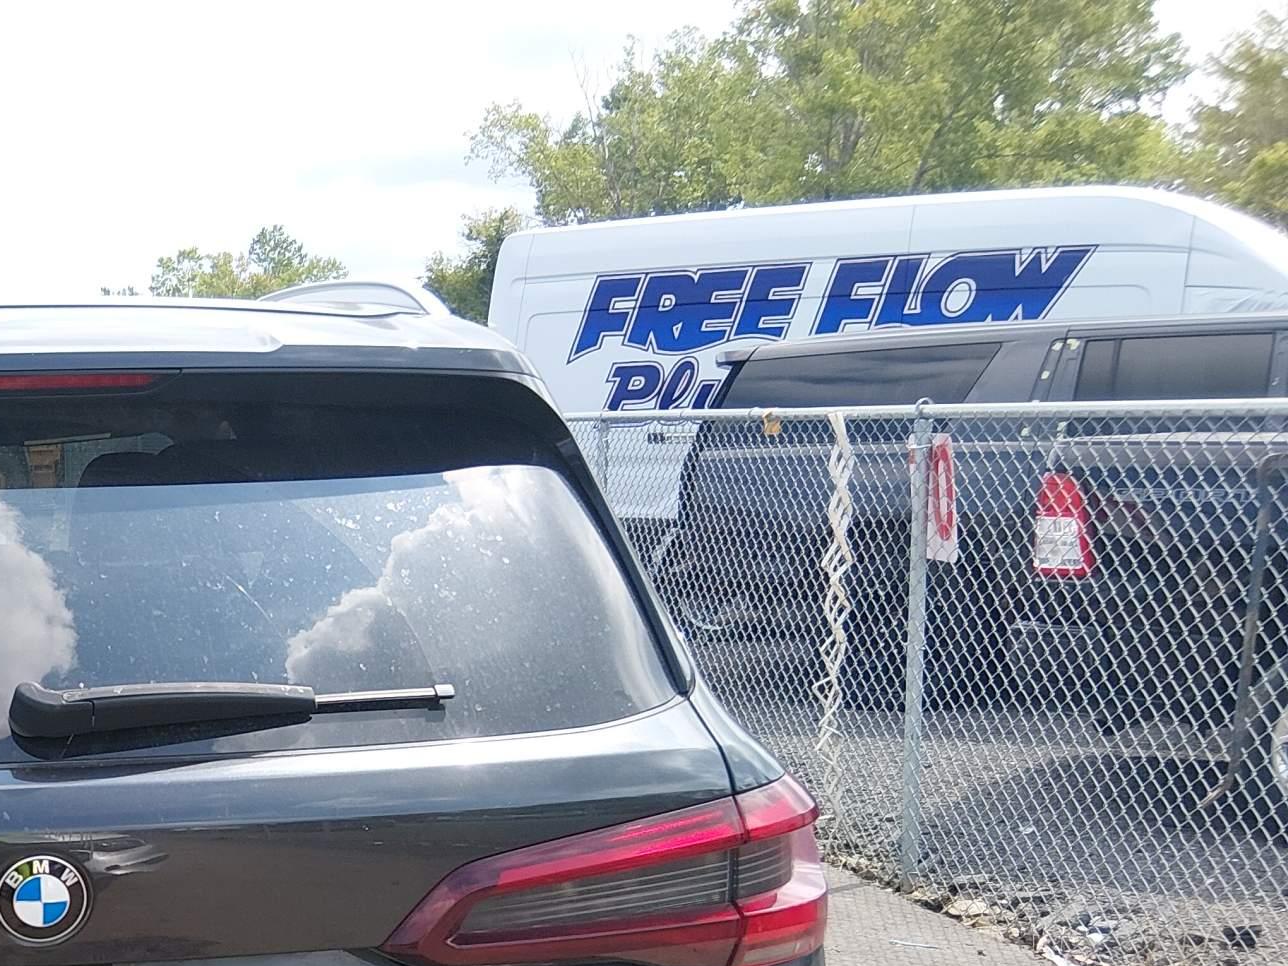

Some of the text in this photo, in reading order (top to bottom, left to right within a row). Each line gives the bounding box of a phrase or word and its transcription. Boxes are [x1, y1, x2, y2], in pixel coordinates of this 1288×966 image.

[567, 244, 1100, 364] FREE FLOW
[5, 860, 79, 889] BMW
